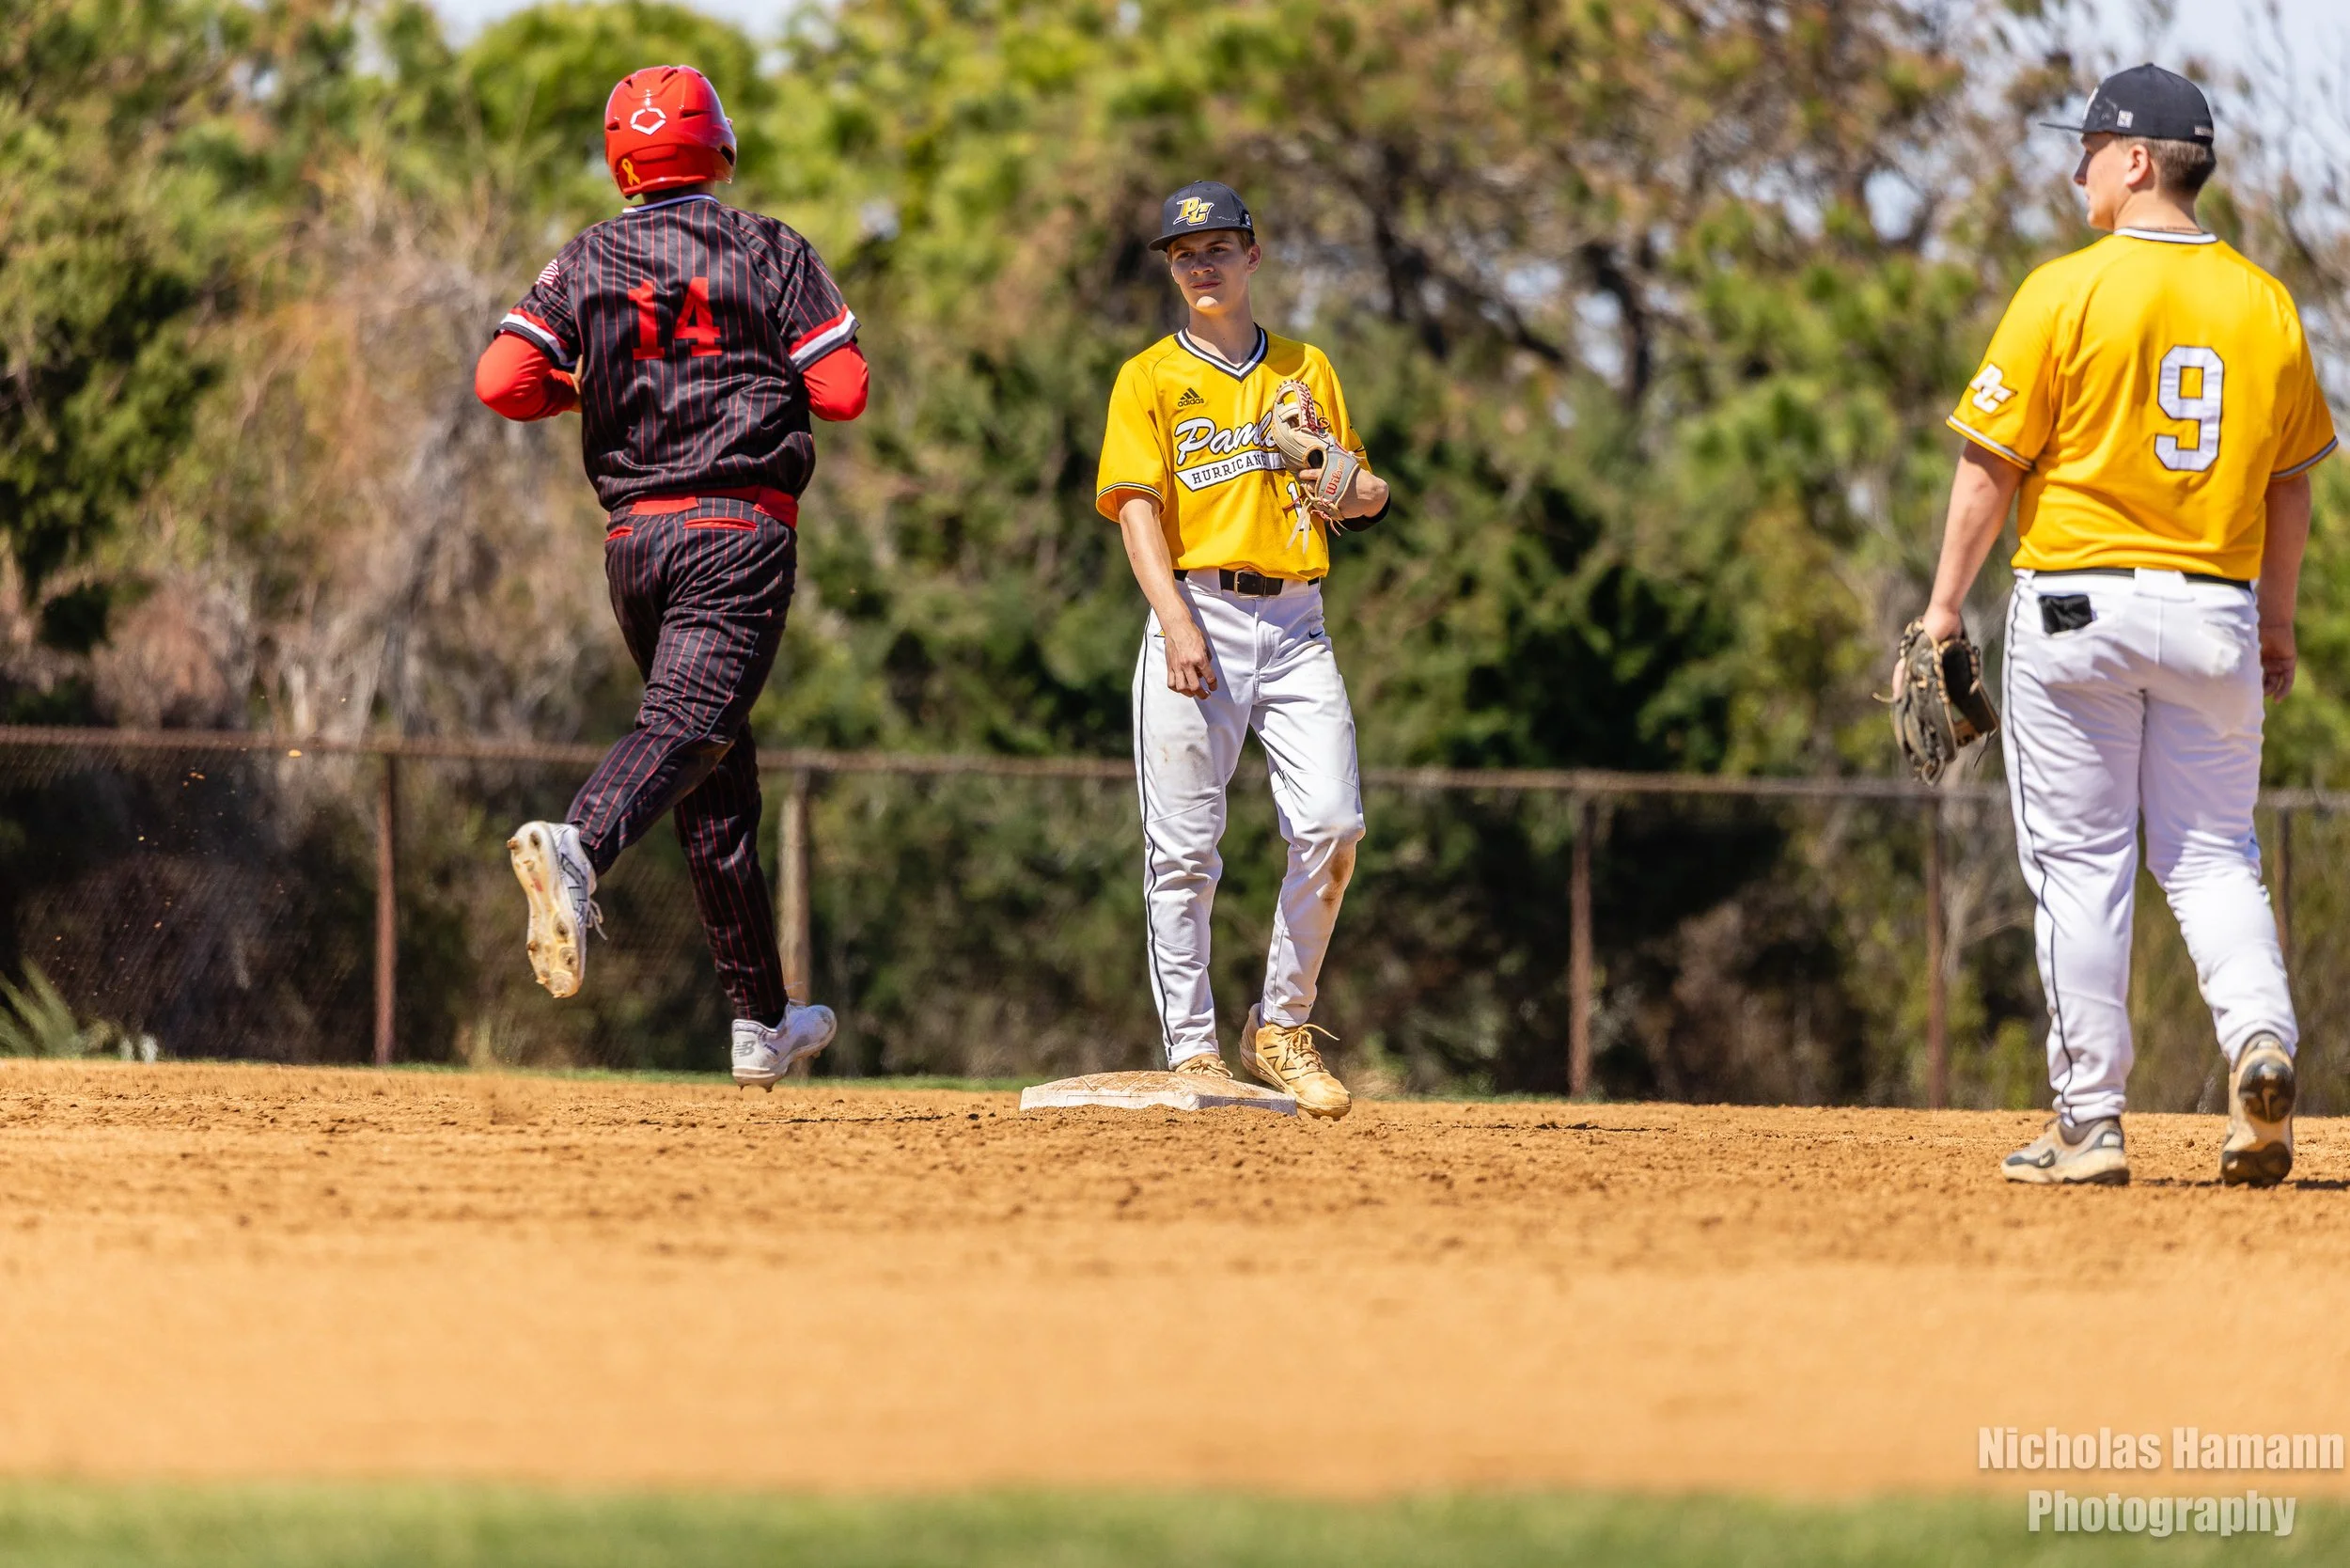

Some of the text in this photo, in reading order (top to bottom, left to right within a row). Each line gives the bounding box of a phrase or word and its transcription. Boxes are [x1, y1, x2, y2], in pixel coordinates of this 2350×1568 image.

[1173, 196, 1214, 226] PC
[627, 276, 723, 361] 14
[1177, 396, 1204, 407] adidas
[2154, 345, 2224, 472] 9
[1324, 458, 1345, 495] Wilson
